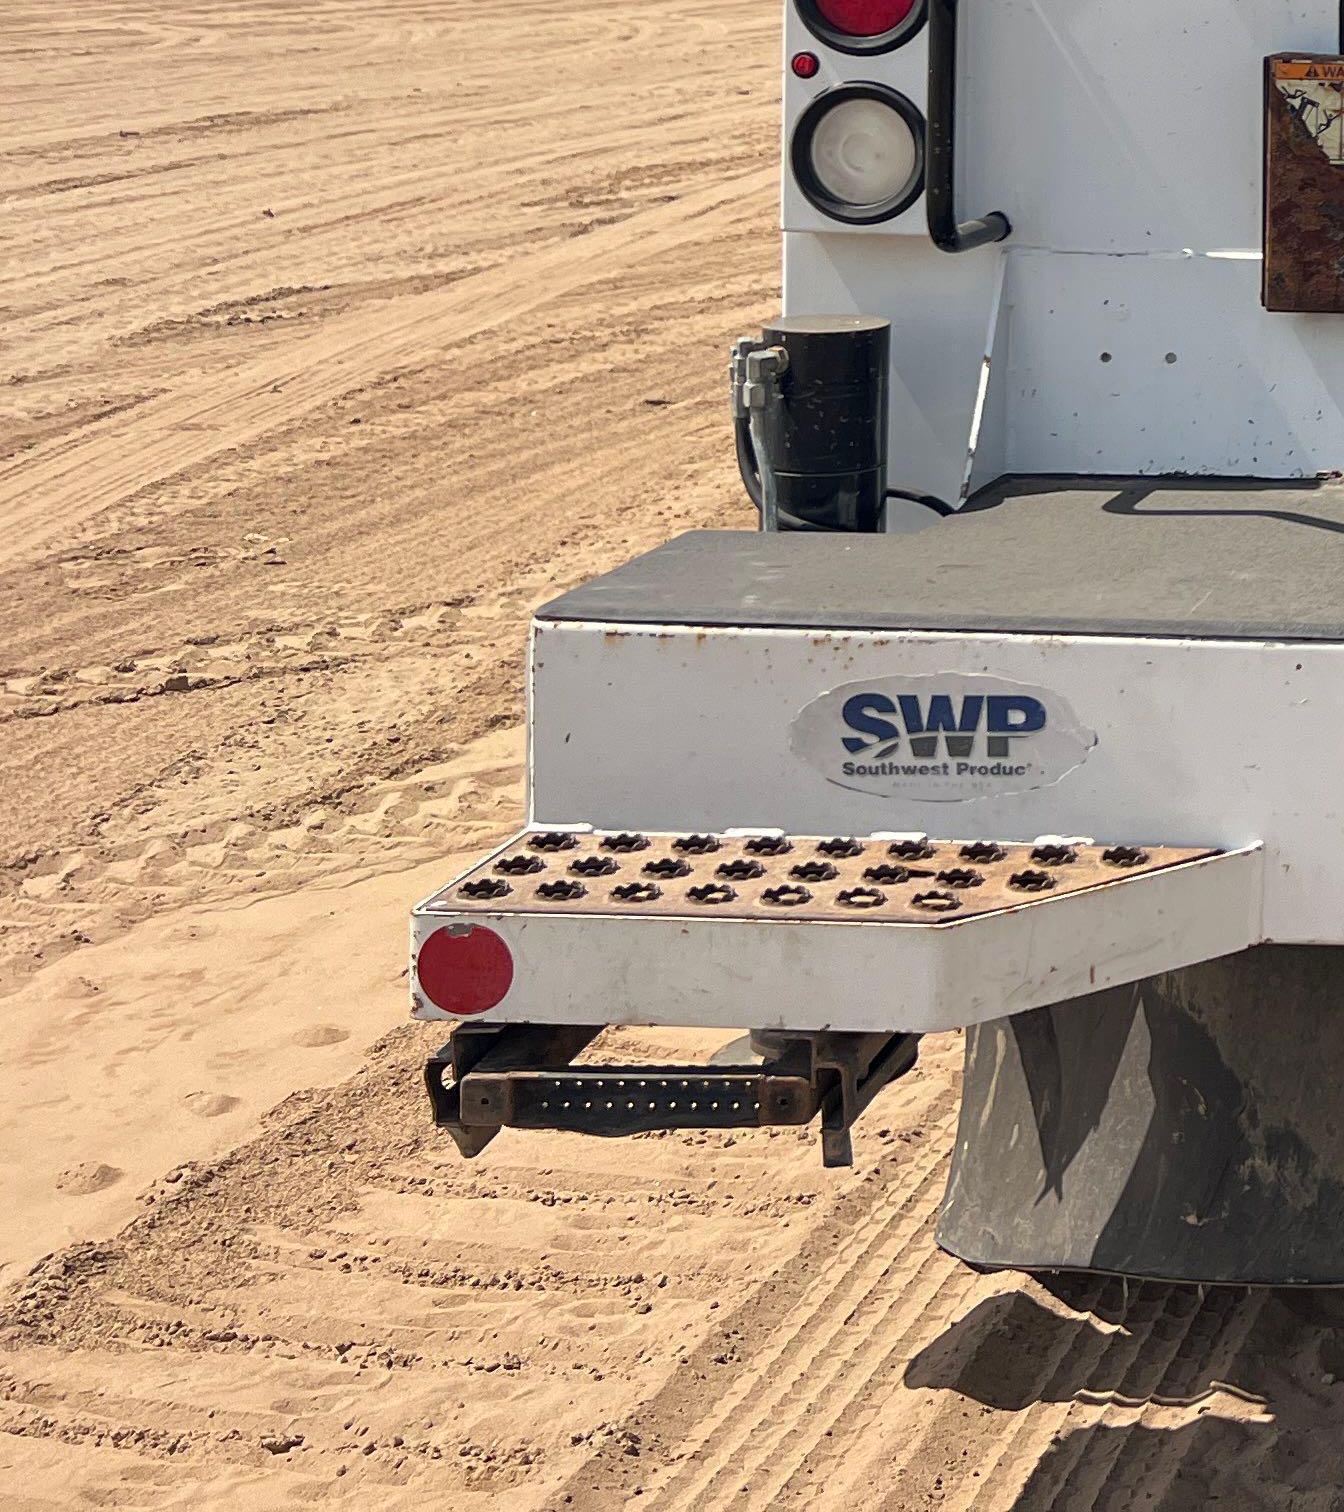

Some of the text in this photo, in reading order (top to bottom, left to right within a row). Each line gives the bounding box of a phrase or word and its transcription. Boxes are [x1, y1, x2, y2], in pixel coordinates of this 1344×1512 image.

[840, 691, 1048, 759] SWP
[841, 761, 1033, 777] Southwest Produc
